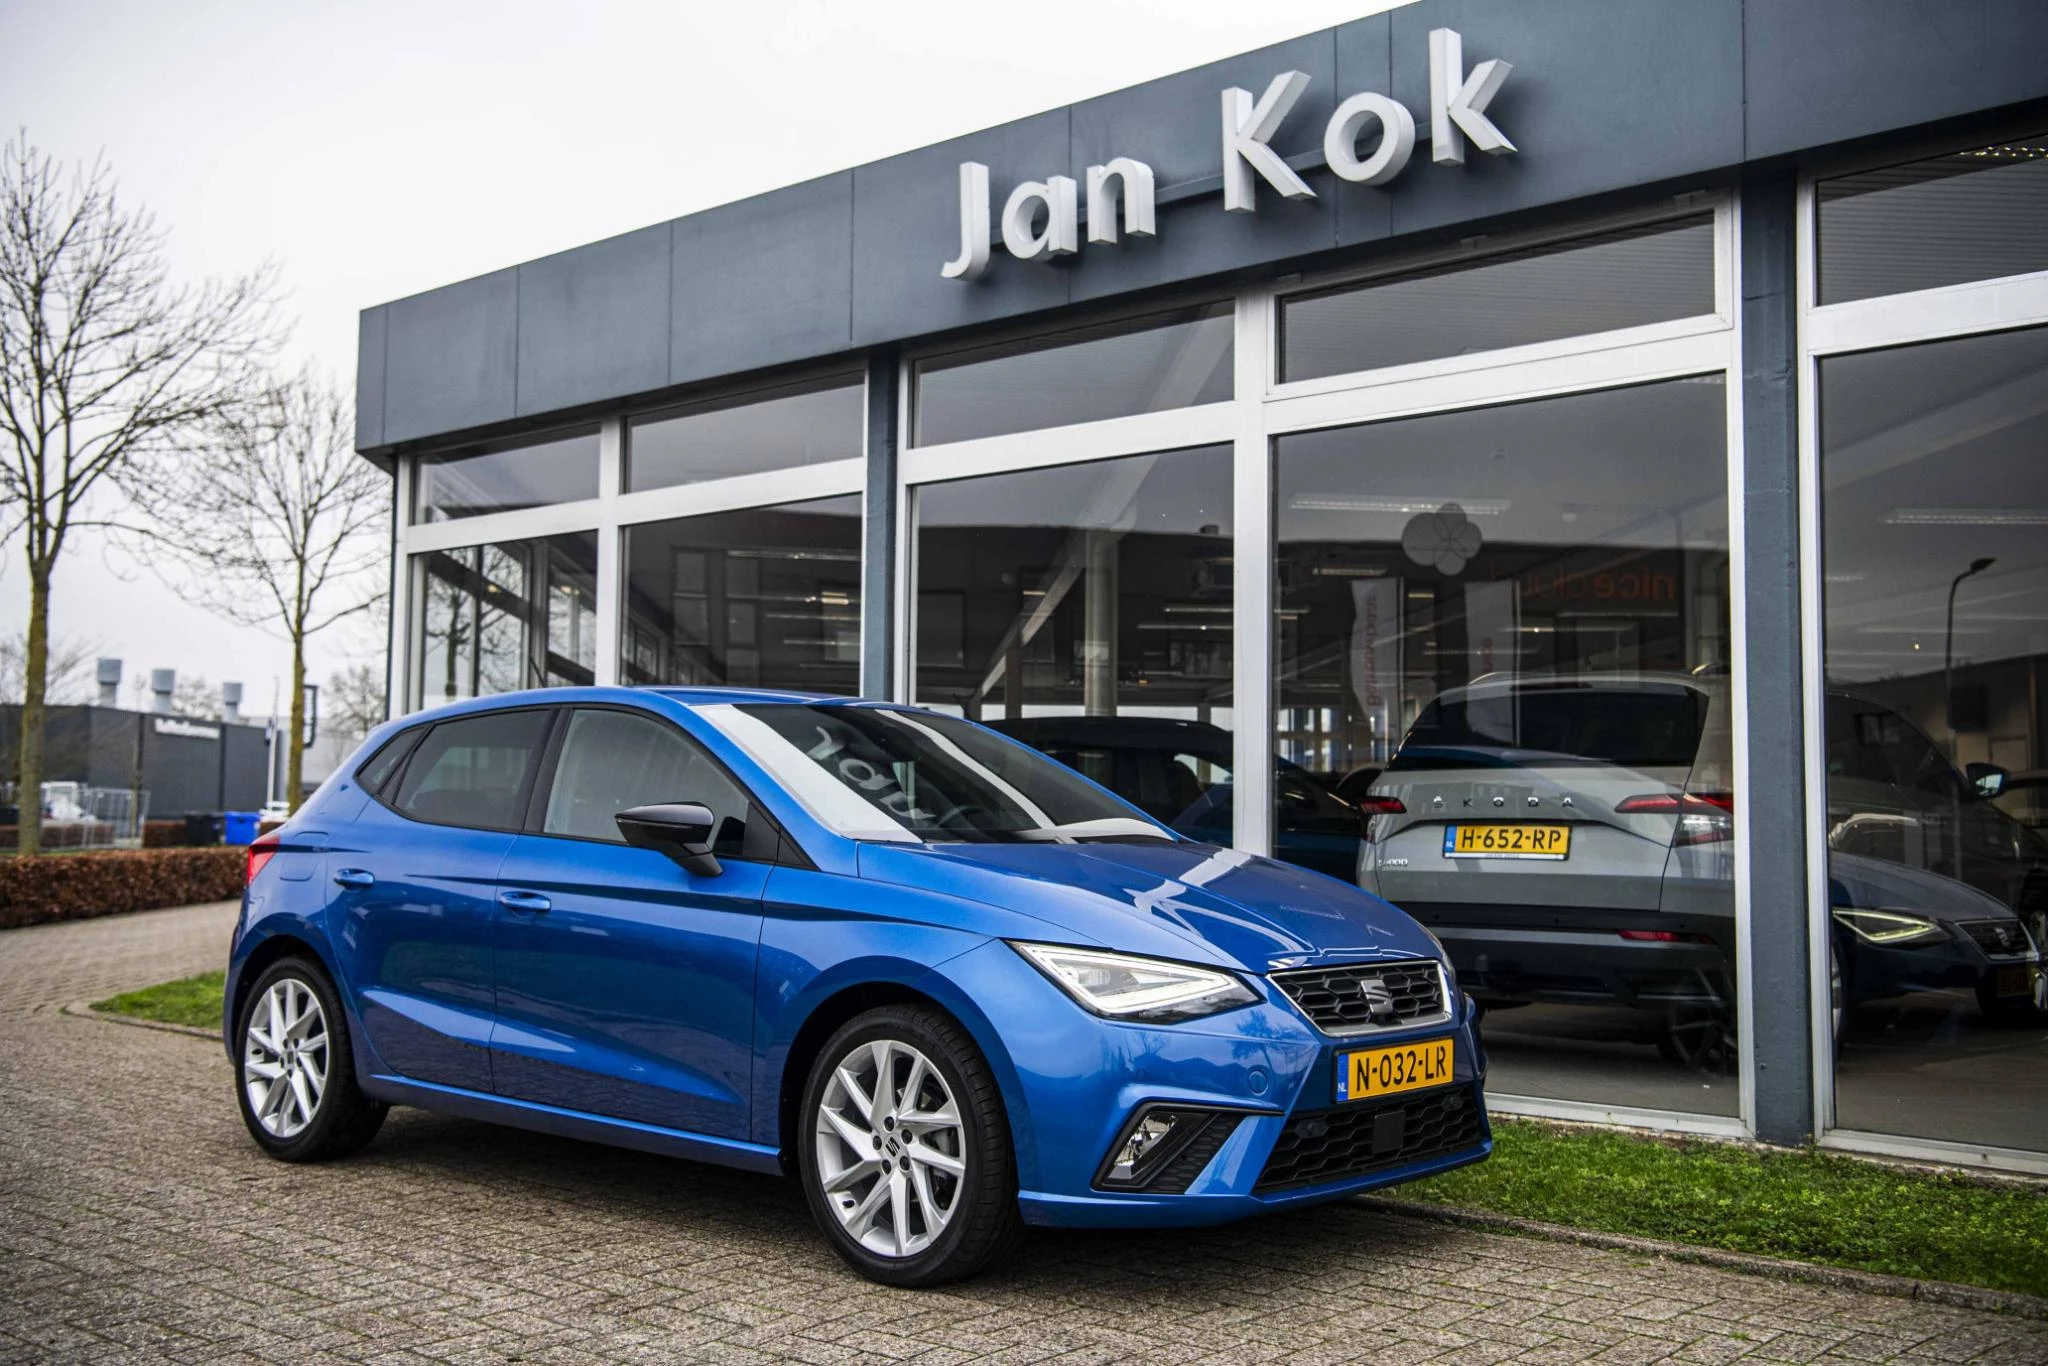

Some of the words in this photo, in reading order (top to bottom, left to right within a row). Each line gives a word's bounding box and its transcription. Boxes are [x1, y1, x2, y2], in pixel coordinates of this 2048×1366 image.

[941, 157, 1156, 281] Jan
[1221, 27, 1518, 213] Kok
[1462, 829, 1562, 849] H-652-RP
[1337, 1082, 1347, 1093] NL
[1356, 1046, 1446, 1091] N-032-LR
